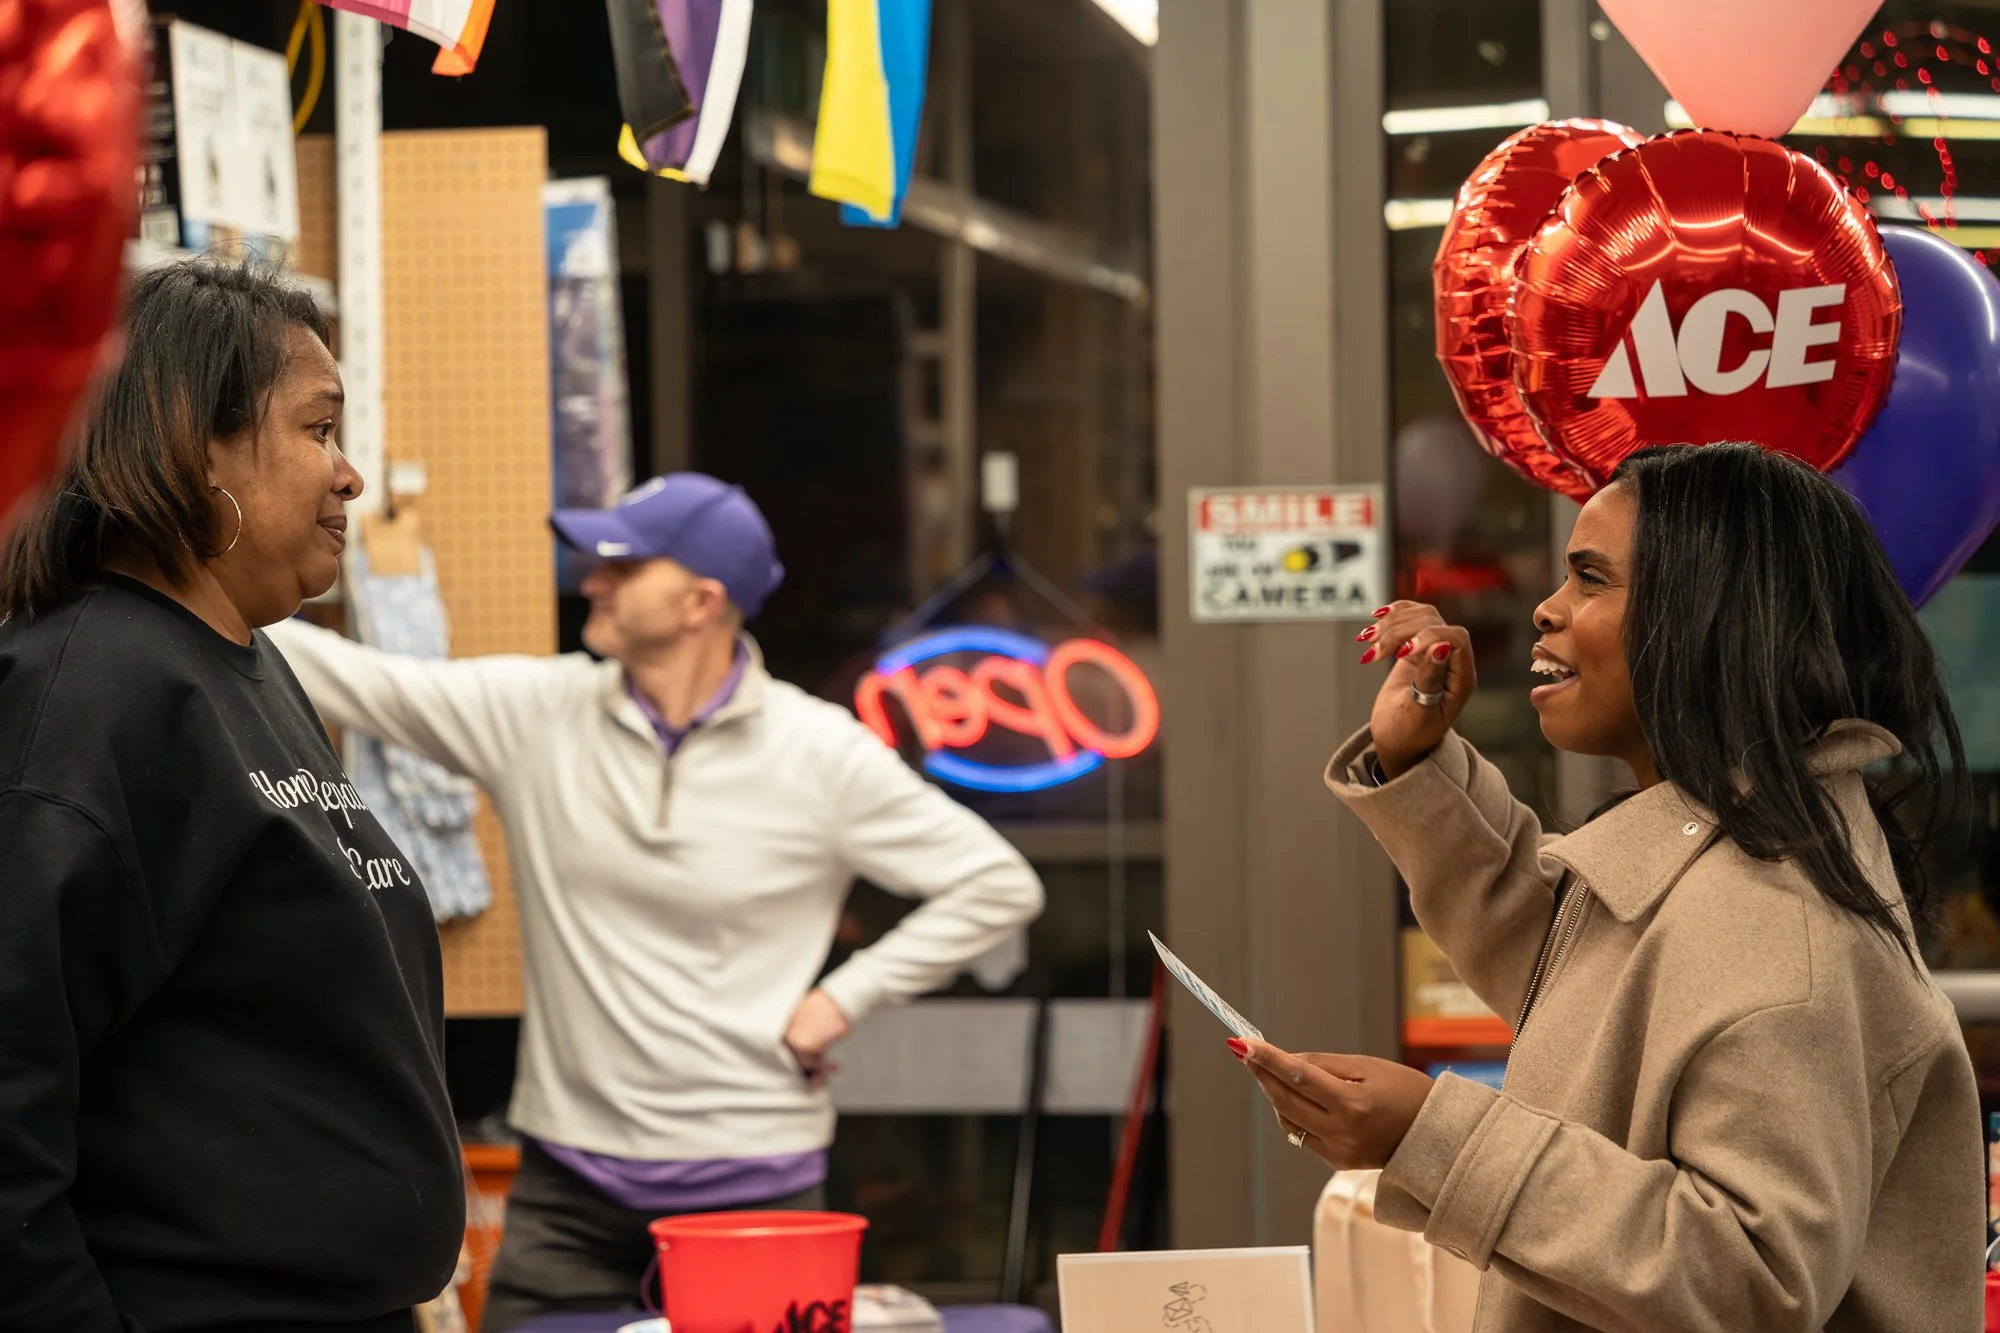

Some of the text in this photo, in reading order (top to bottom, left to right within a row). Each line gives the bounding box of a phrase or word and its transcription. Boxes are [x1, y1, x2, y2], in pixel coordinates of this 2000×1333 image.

[1586, 277, 1847, 398] ACE
[1208, 493, 1366, 529] SMILE
[1203, 582, 1368, 607] CAMERA
[772, 1299, 848, 1333] ACE
